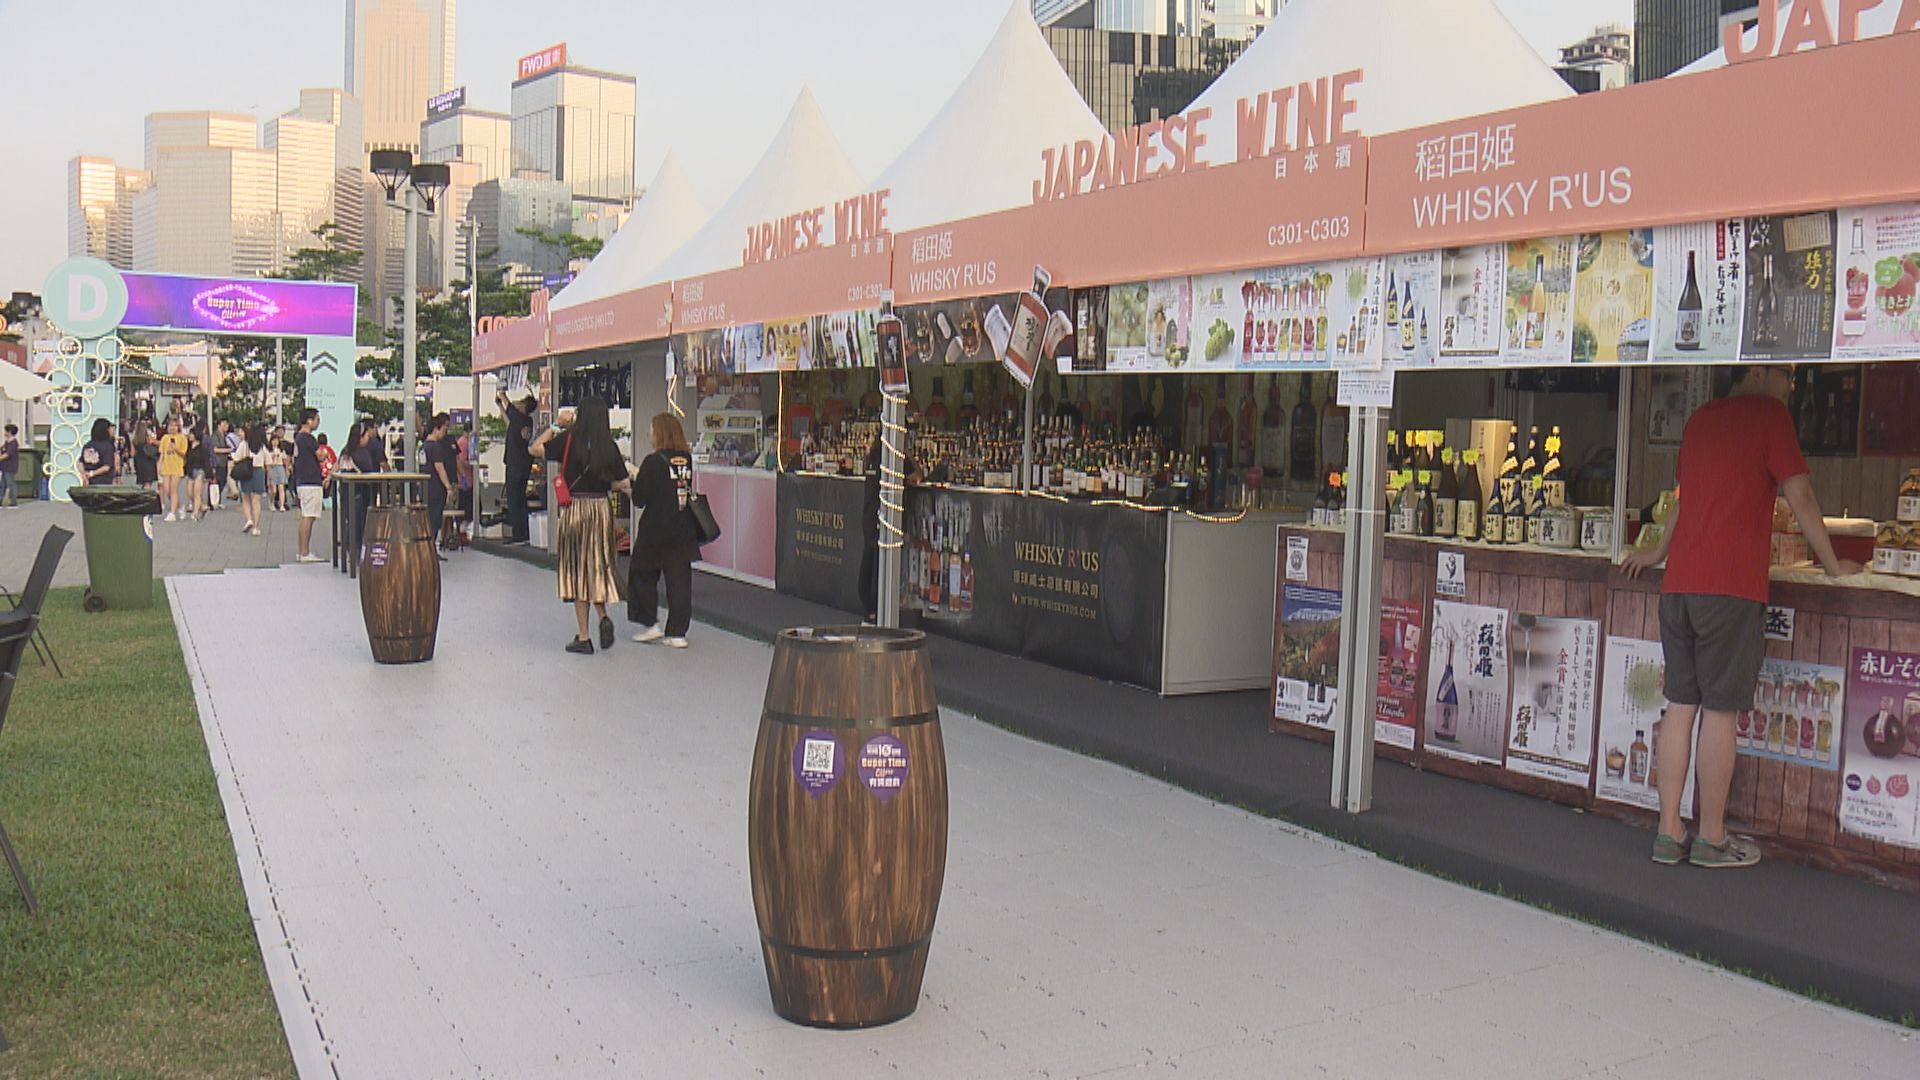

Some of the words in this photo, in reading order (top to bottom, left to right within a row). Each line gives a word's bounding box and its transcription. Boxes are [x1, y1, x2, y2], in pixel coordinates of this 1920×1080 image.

[522, 54, 543, 77] FWD
[1032, 106, 1213, 205] JAPANESE
[1236, 68, 1364, 163] WINE
[1275, 145, 1351, 180] 日本酒
[1413, 179, 1539, 228] WHISKY
[1549, 166, 1632, 210] R'US
[741, 205, 825, 268] JAPANESE
[834, 188, 892, 247] WINE
[1267, 216, 1350, 247] C301-C303
[909, 265, 960, 294] WHISKY
[963, 261, 996, 286] R'US
[67, 273, 108, 321] D
[681, 305, 708, 326] WHISKY
[796, 508, 823, 526] WHISKY
[1014, 541, 1065, 566] WHISKY
[1067, 548, 1099, 572] R'US
[862, 758, 887, 768] Super
[887, 758, 907, 768] Time
